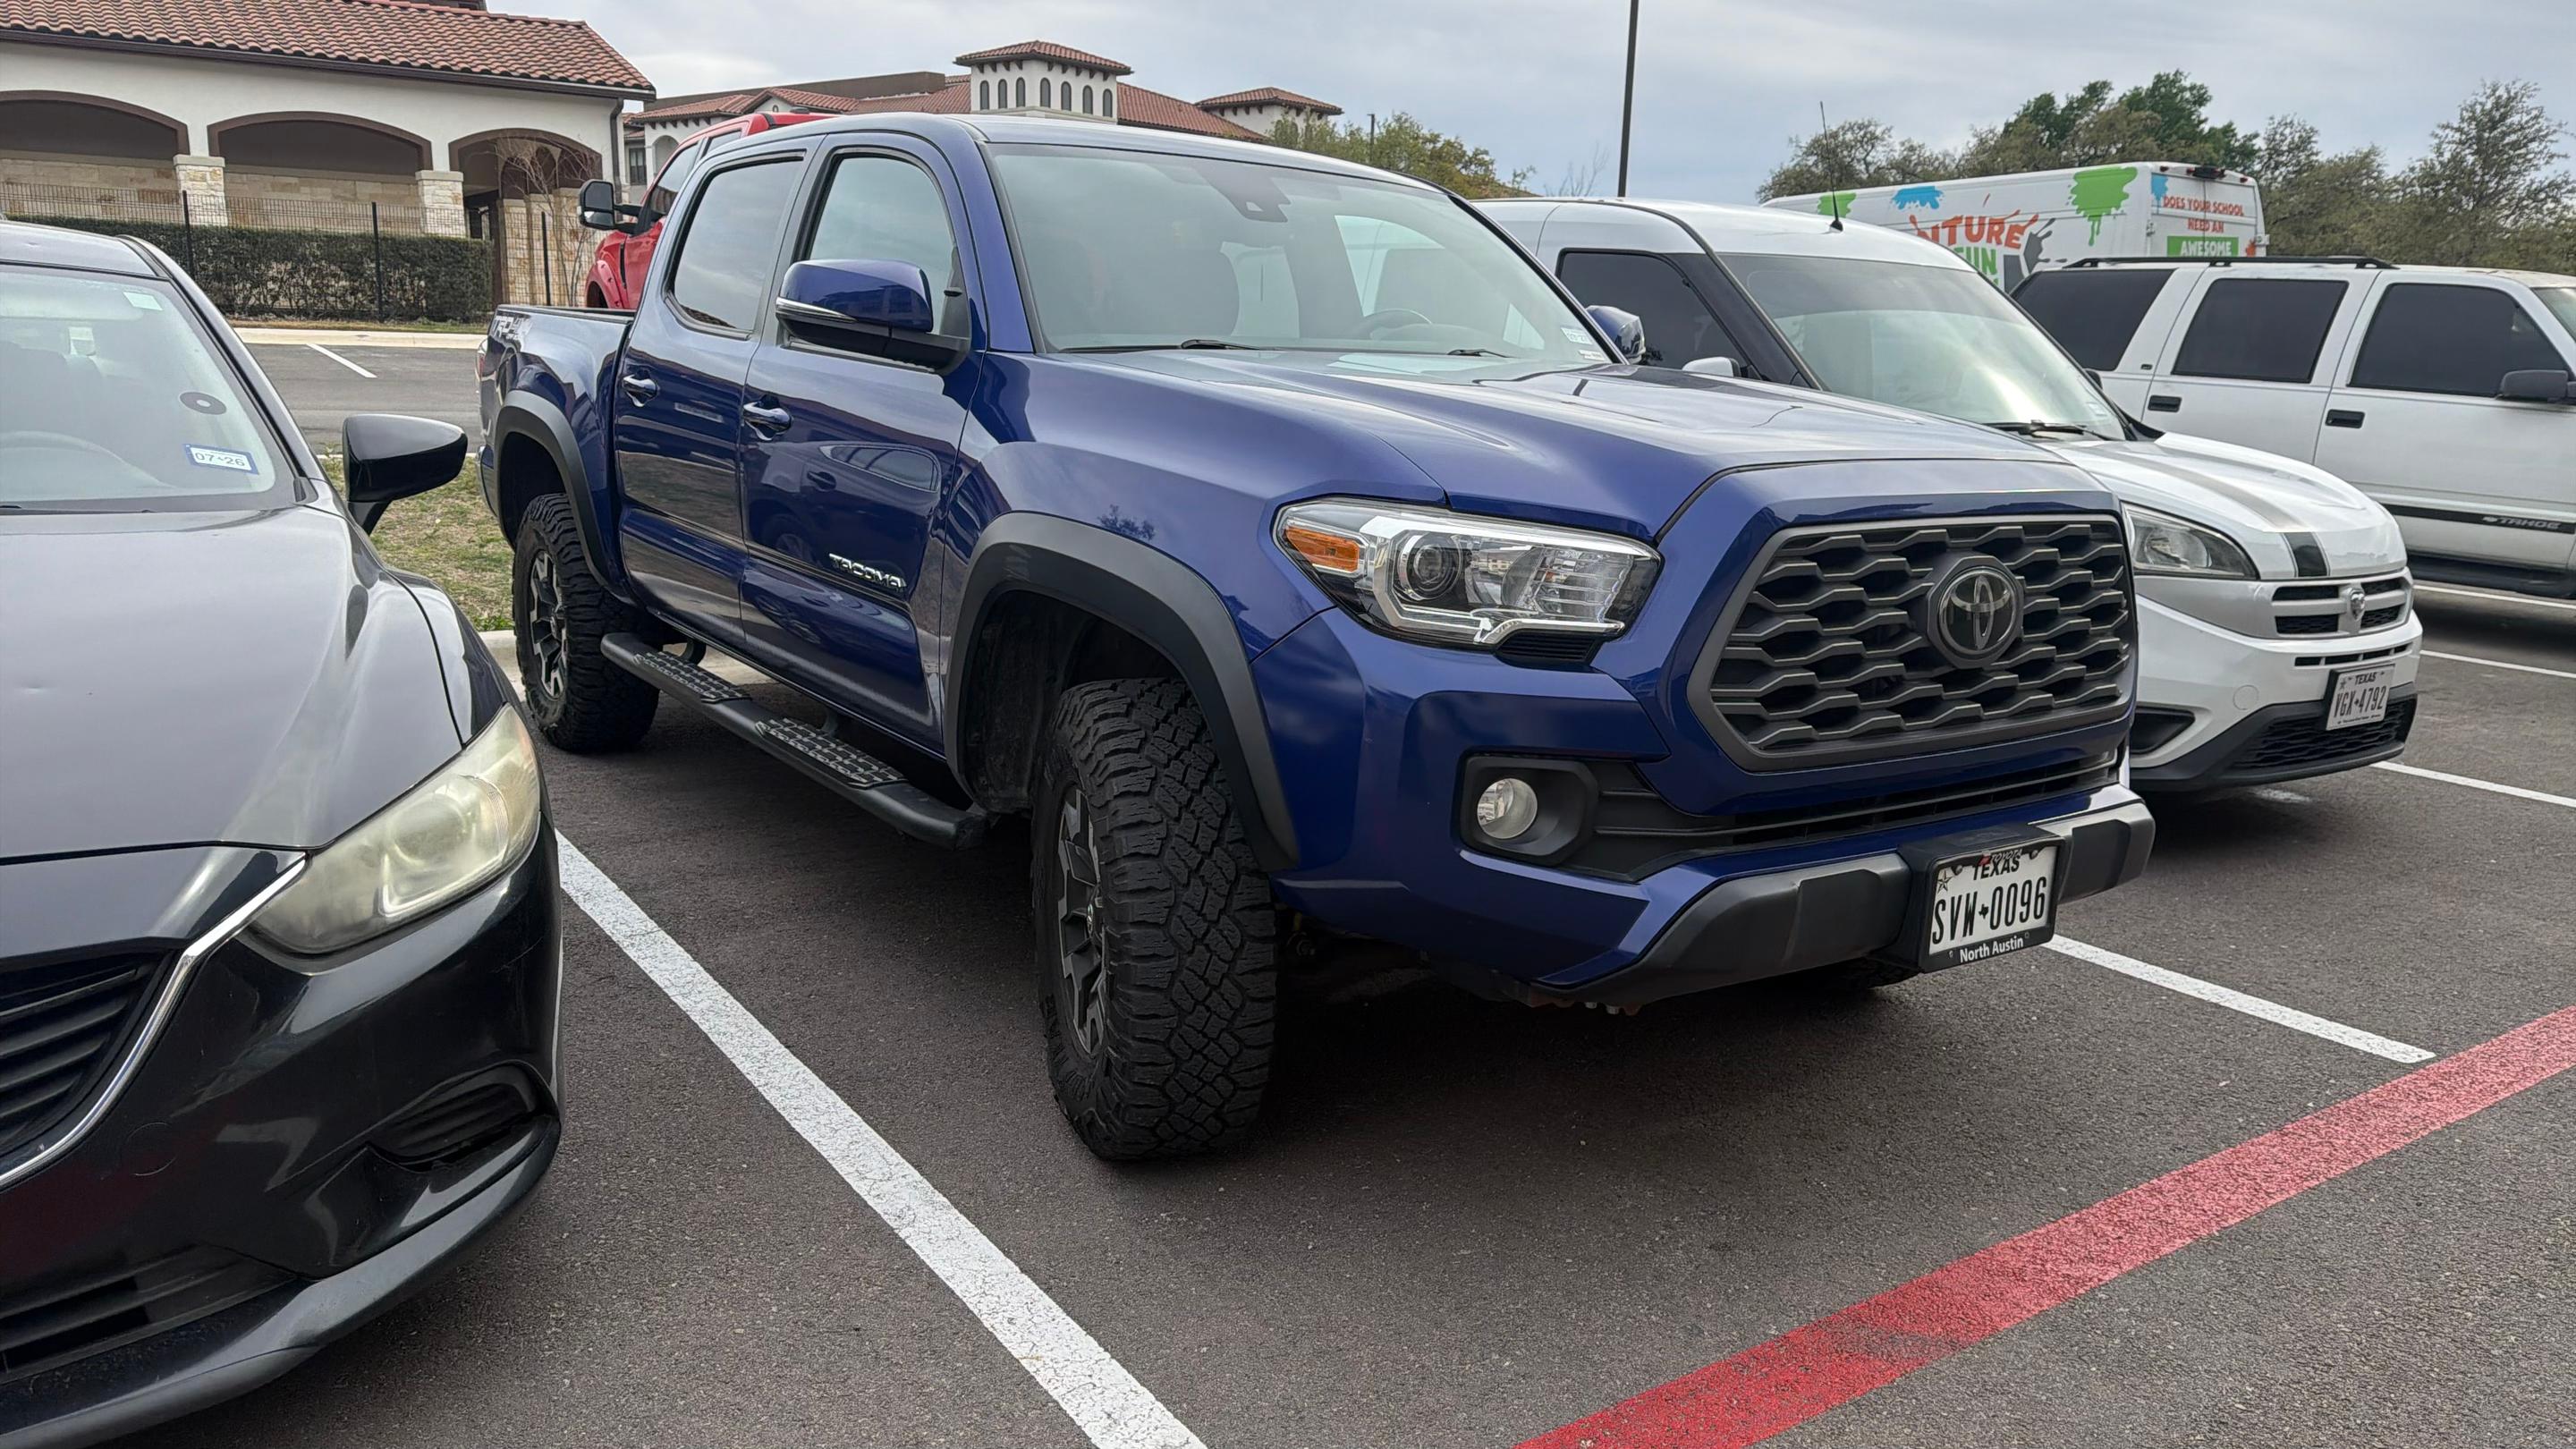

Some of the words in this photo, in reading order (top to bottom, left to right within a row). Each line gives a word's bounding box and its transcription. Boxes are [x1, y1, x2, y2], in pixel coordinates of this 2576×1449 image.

[2163, 195, 2185, 210] DOES
[2188, 199, 2211, 213] YOUR
[2213, 201, 2244, 216] SCHOOL
[2188, 217, 2209, 232] NEED
[2212, 220, 2224, 233] AN
[2181, 240, 2233, 258] AWESOME
[2499, 516, 2562, 530] TAHOE
[829, 553, 907, 591] TACOMA
[2355, 672, 2377, 685] TEXAS
[1973, 856, 2020, 880] TEXAS
[1960, 943, 1990, 963] North
[1992, 936, 2024, 955] Austin
